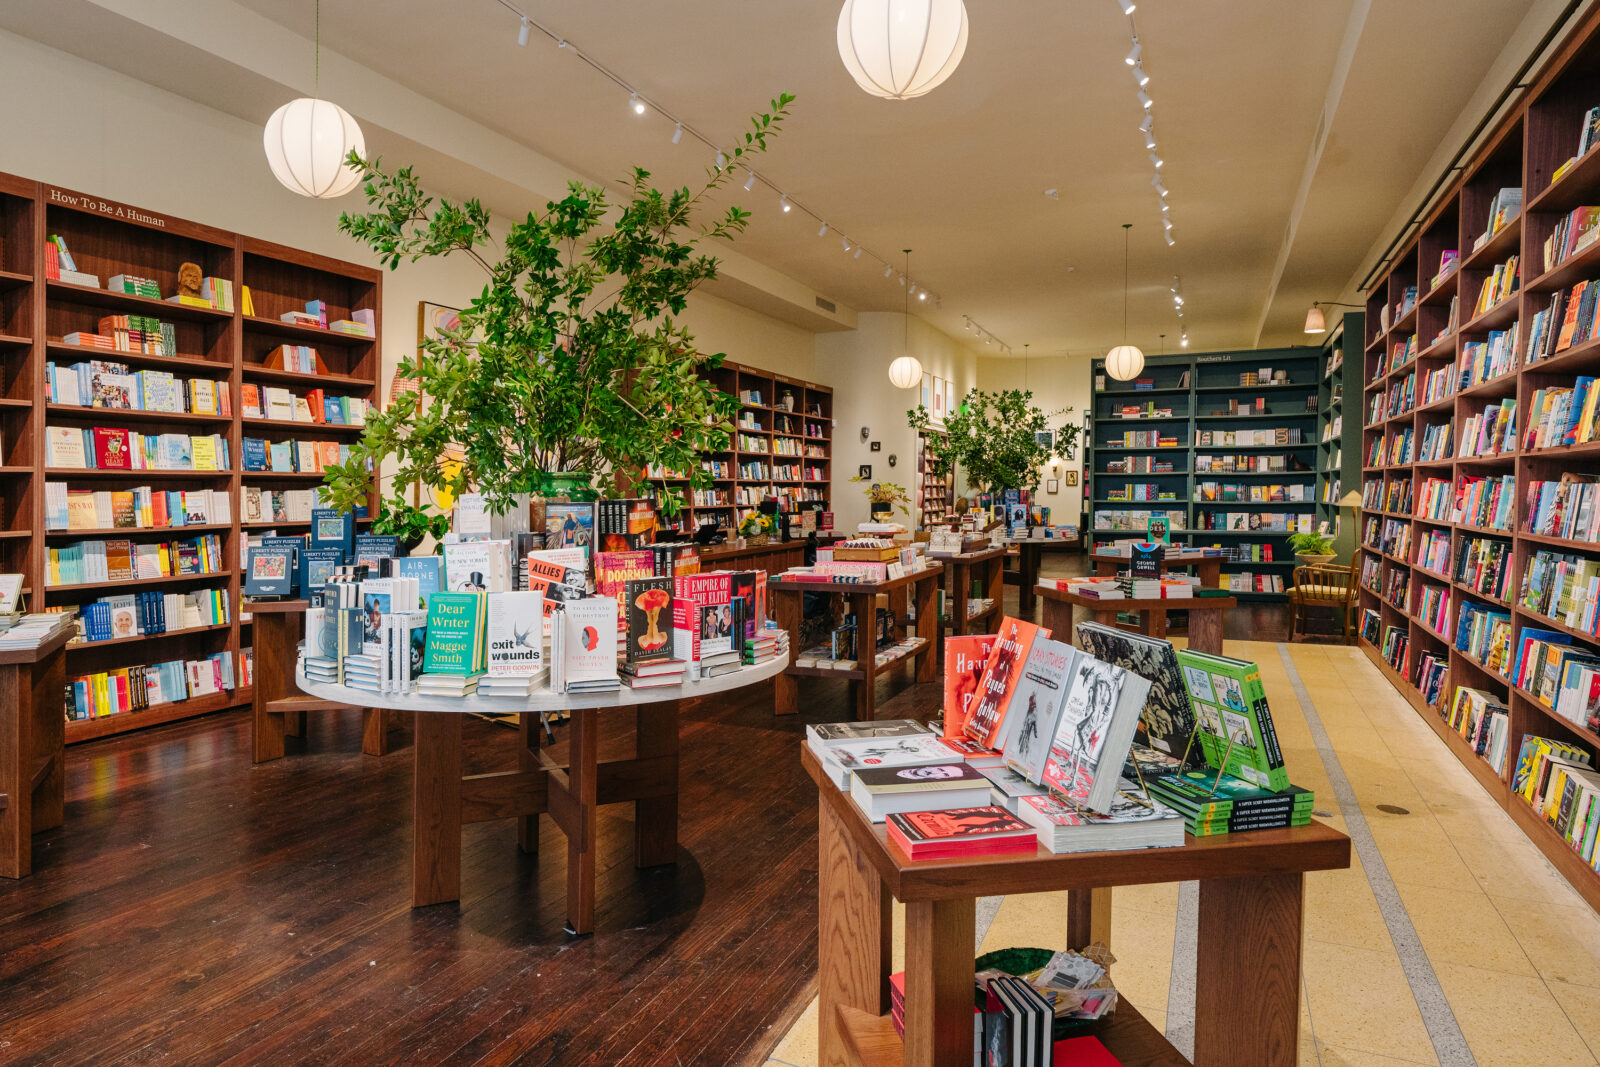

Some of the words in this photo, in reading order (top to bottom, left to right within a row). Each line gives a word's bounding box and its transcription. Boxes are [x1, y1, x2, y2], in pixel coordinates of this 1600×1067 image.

[50, 190, 78, 205] How
[80, 197, 96, 210] To
[99, 202, 113, 214] Be
[115, 207, 124, 217] A
[127, 209, 165, 227] Human
[532, 562, 560, 578] ALLIES
[624, 560, 636, 568] THE
[608, 568, 652, 582] DOORMAN
[635, 581, 672, 592] FLESH
[692, 579, 718, 592] EMPIRE
[720, 578, 728, 589] OF
[692, 593, 707, 605] THE
[709, 590, 728, 603] ELITE
[438, 604, 466, 614] Dear
[432, 617, 470, 628] Writer
[431, 641, 467, 653] Maggie
[491, 640, 514, 649] exit
[994, 630, 1024, 660] Haunting
[433, 653, 462, 663] Smith
[492, 650, 540, 661] wounds
[956, 653, 987, 673] Haun
[1000, 661, 1006, 670] of
[982, 670, 1006, 695] Paynes
[977, 697, 1000, 723] Hollow
